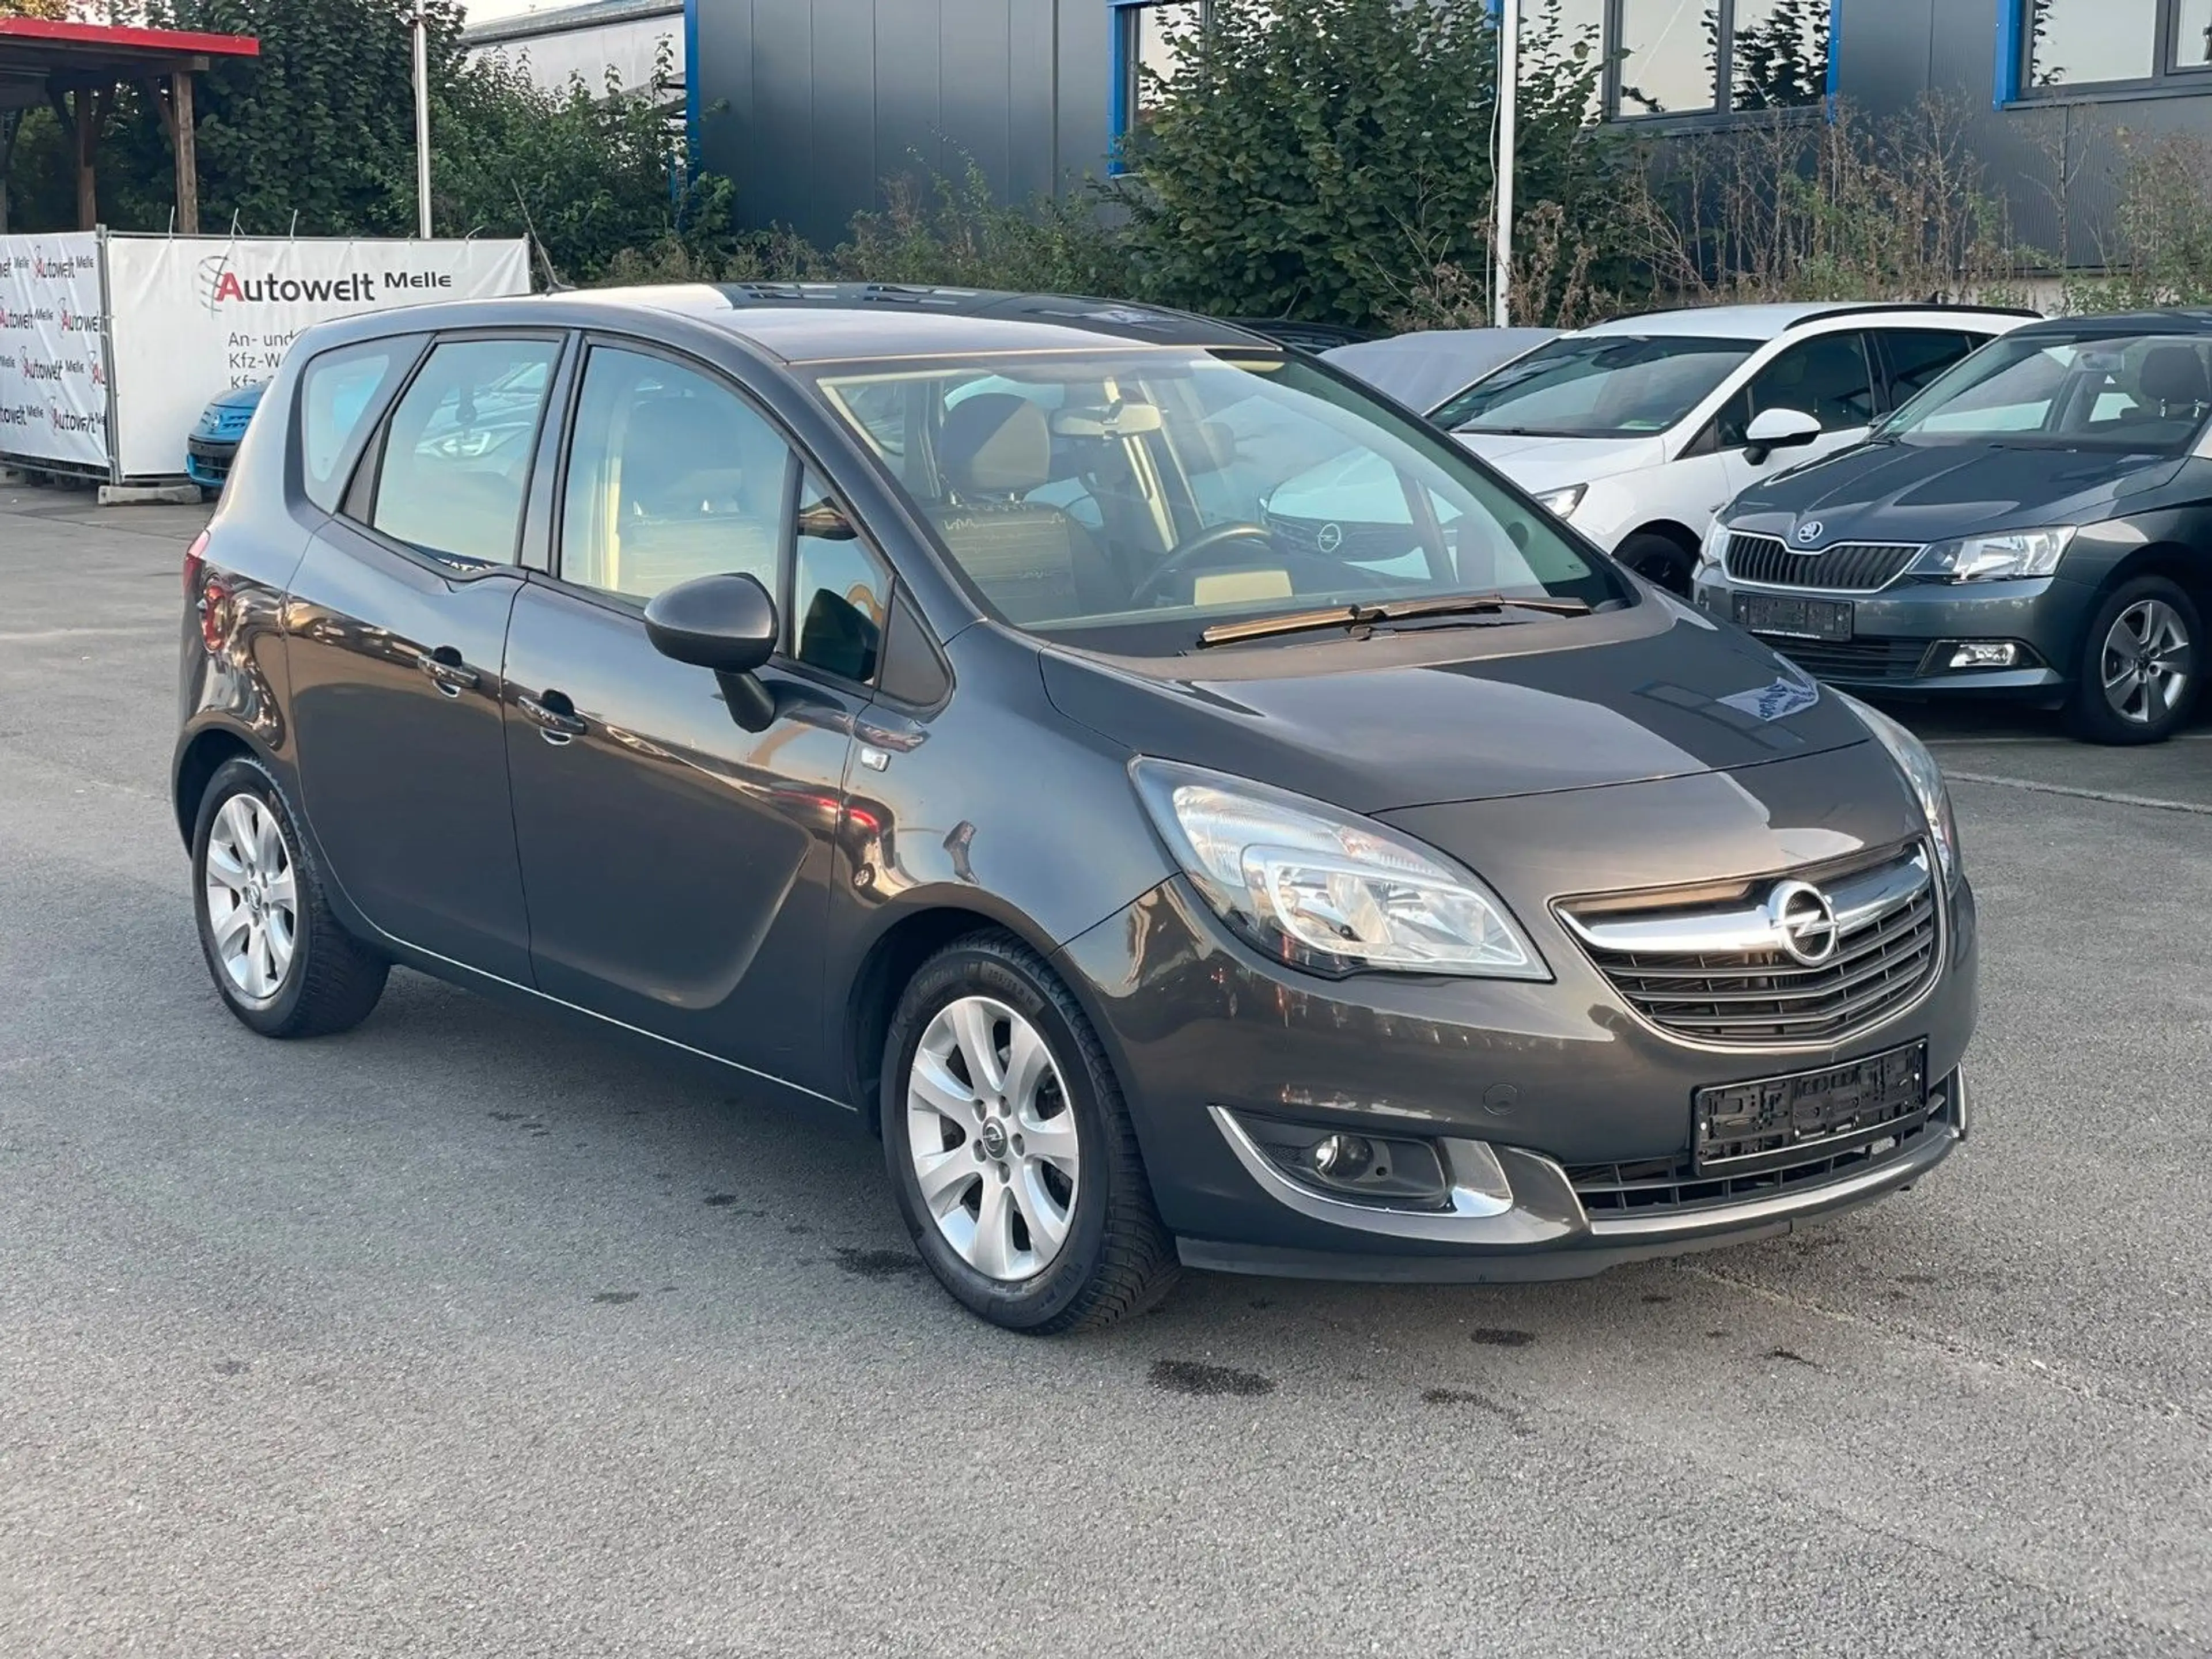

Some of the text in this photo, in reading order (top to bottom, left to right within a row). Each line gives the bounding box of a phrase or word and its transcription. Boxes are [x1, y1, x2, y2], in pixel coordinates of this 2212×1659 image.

[214, 271, 452, 302] Autowelt Melle
[228, 331, 257, 347] An-
